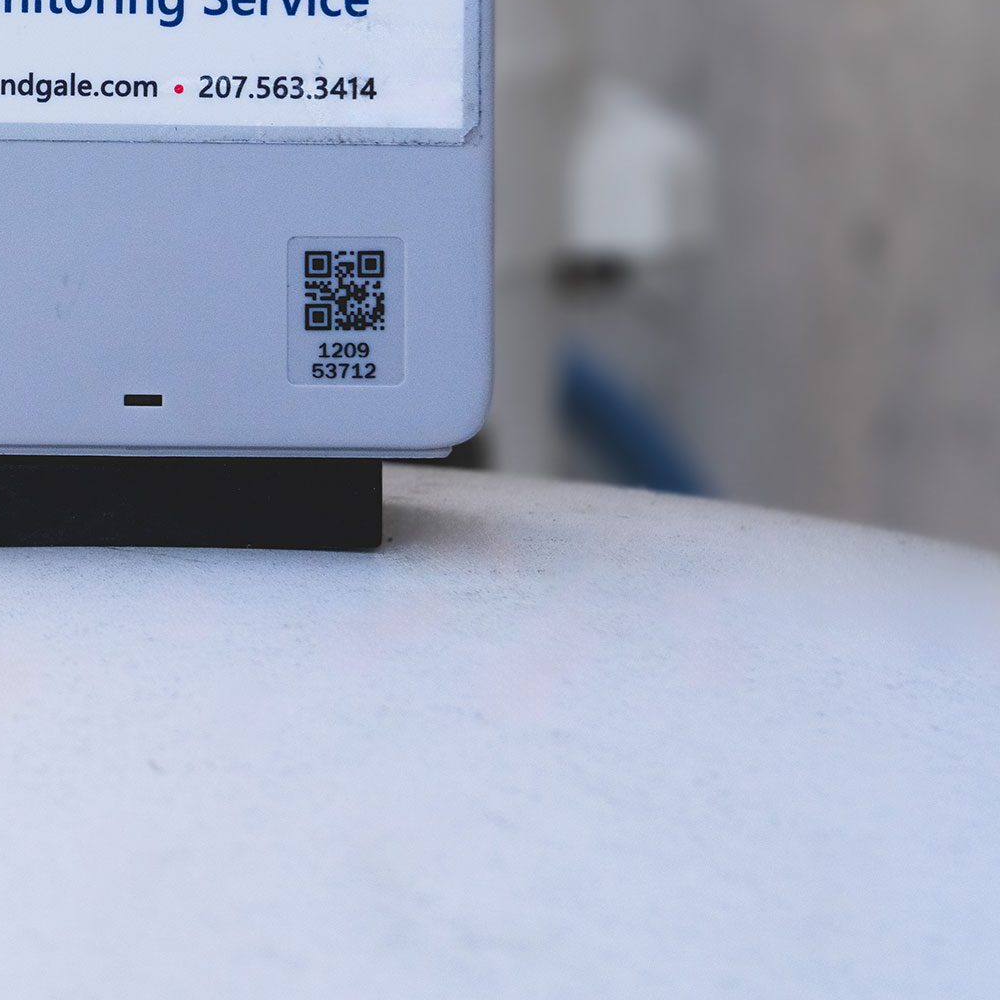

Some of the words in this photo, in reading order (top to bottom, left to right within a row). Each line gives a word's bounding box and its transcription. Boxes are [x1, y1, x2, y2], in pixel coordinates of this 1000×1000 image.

[198, 74, 378, 100] 207.563.3414
[318, 342, 370, 359] 1209
[311, 362, 377, 380] 53712
